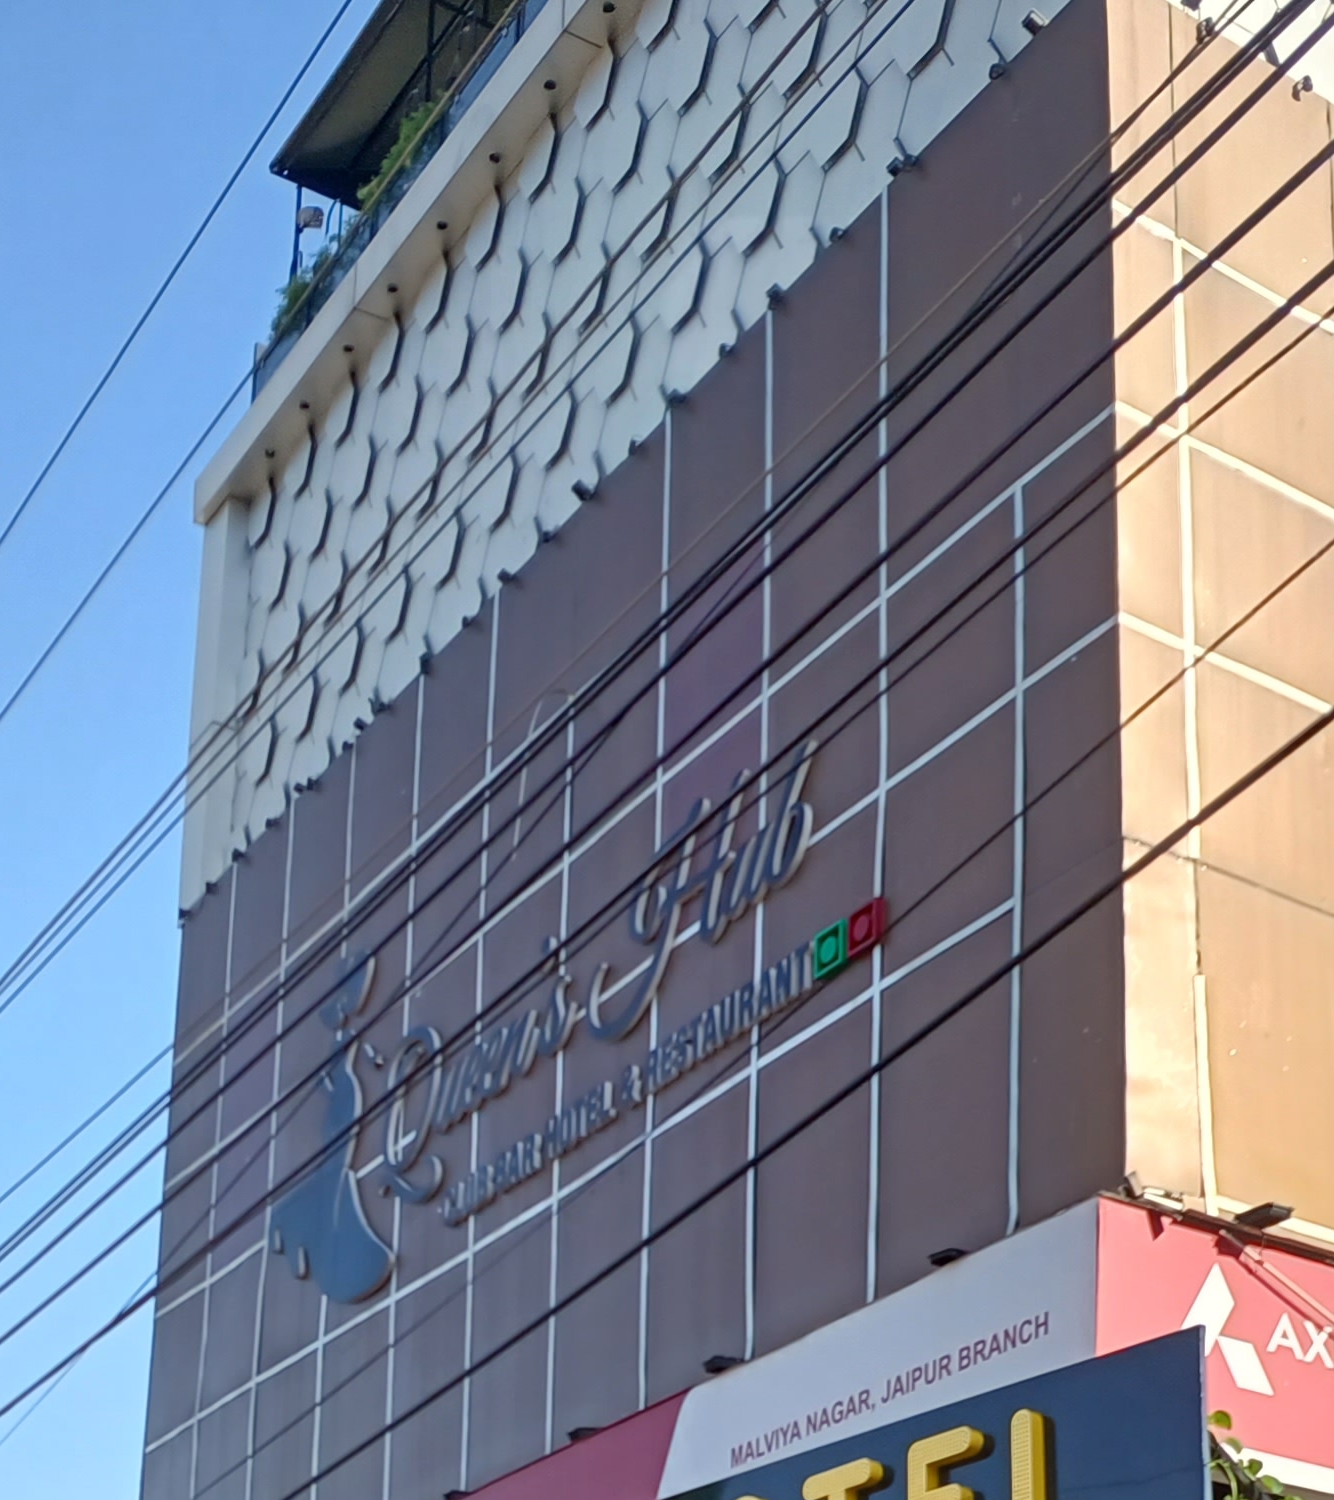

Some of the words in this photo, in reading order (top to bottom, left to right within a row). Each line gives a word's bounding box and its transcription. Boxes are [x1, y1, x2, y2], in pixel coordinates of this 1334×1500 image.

[588, 740, 814, 1042] Hub
[545, 1079, 618, 1161] HOTEL
[622, 1064, 644, 1110] &
[647, 938, 815, 1096] RESTAURANT
[730, 1420, 803, 1469] MALVIYA
[805, 1388, 876, 1437] NAGAR,
[880, 1354, 952, 1404] JAIPUR
[957, 1311, 1050, 1373] BRANCH
